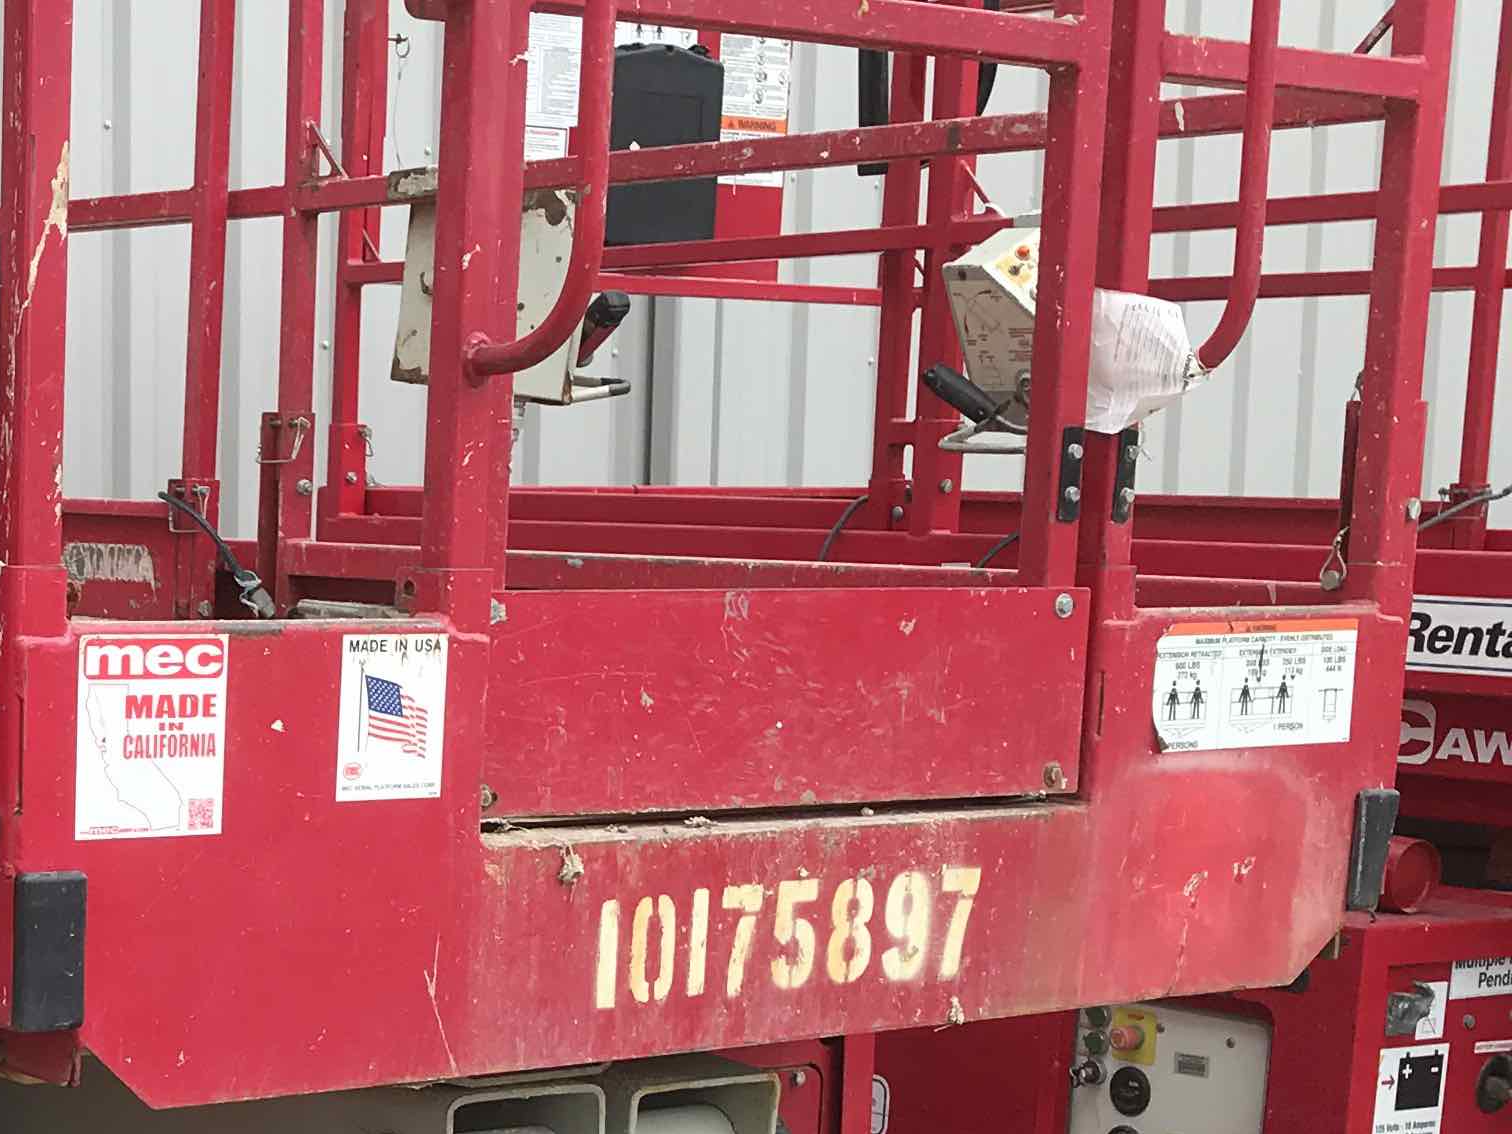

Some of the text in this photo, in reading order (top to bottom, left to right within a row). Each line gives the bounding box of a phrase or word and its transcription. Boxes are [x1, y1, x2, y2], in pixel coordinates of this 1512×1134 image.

[349, 637, 443, 653] MADE IN USA
[85, 643, 223, 676] mec
[124, 693, 217, 719] MADE
[158, 721, 185, 732] IN
[123, 732, 217, 760] CALIFORNIA
[595, 866, 982, 1009] 10175897
